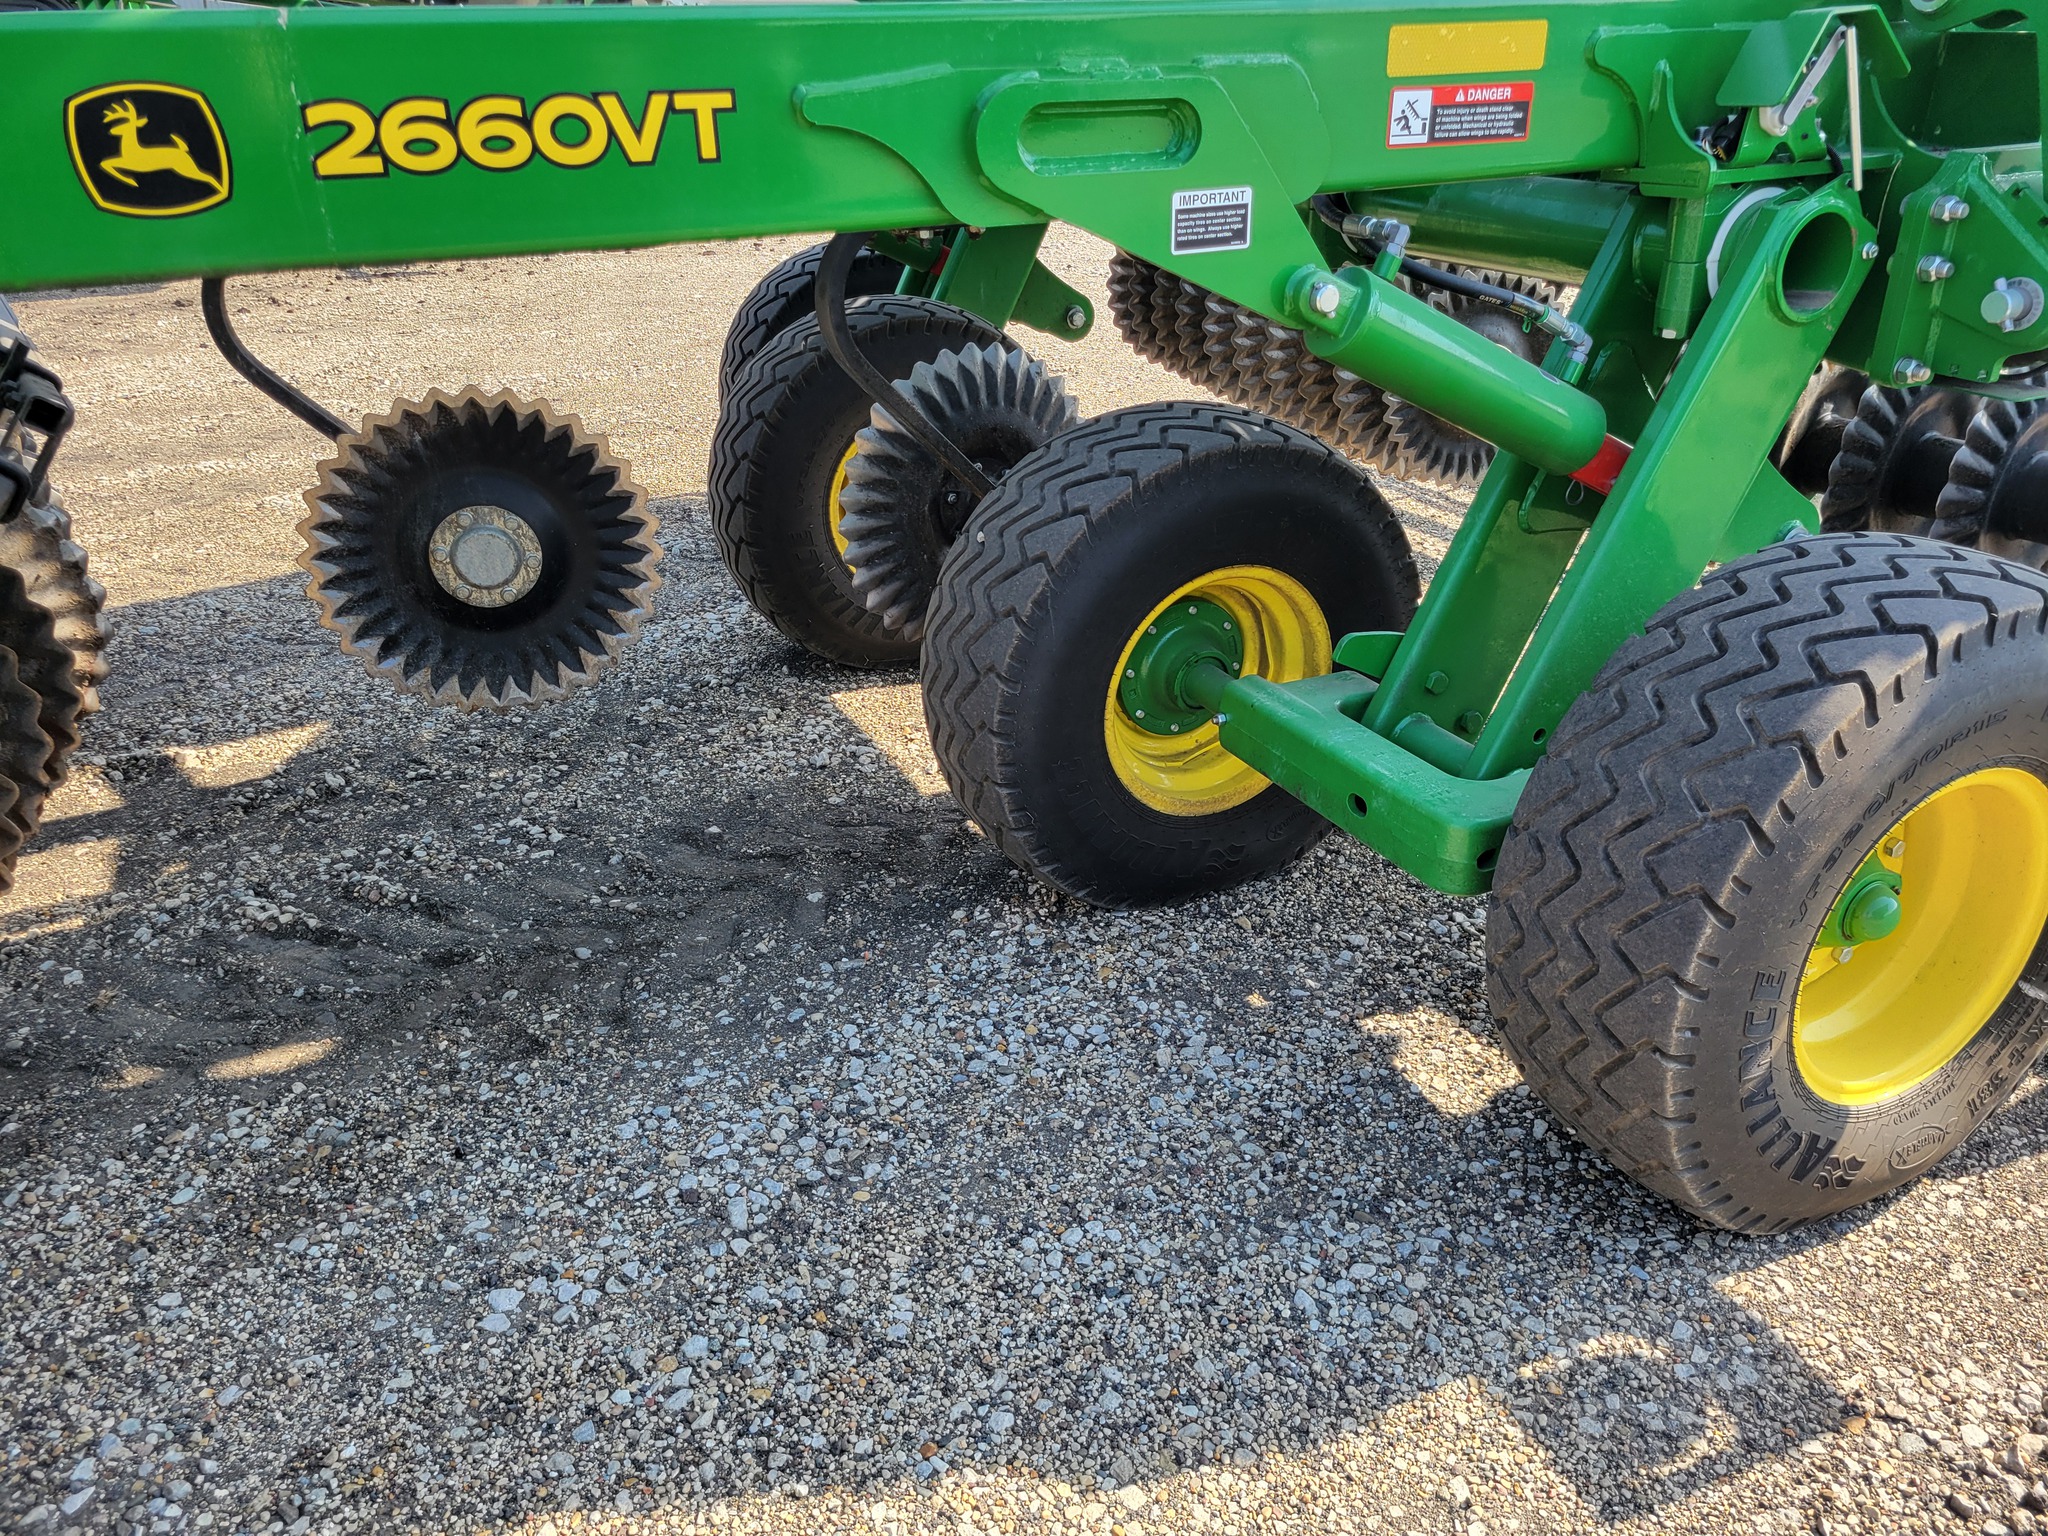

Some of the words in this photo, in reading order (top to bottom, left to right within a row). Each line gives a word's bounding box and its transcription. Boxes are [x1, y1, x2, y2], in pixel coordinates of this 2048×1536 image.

[1467, 87, 1512, 102] DANGER
[1443, 107, 1456, 115] avoid
[1456, 107, 1470, 115] injury
[1474, 114, 1487, 122] wings
[302, 88, 736, 181] 2660VT
[1179, 191, 1247, 206] IMPORTANT
[1479, 295, 1501, 305] GATES
[1741, 970, 1837, 1184] ALLIANCE
